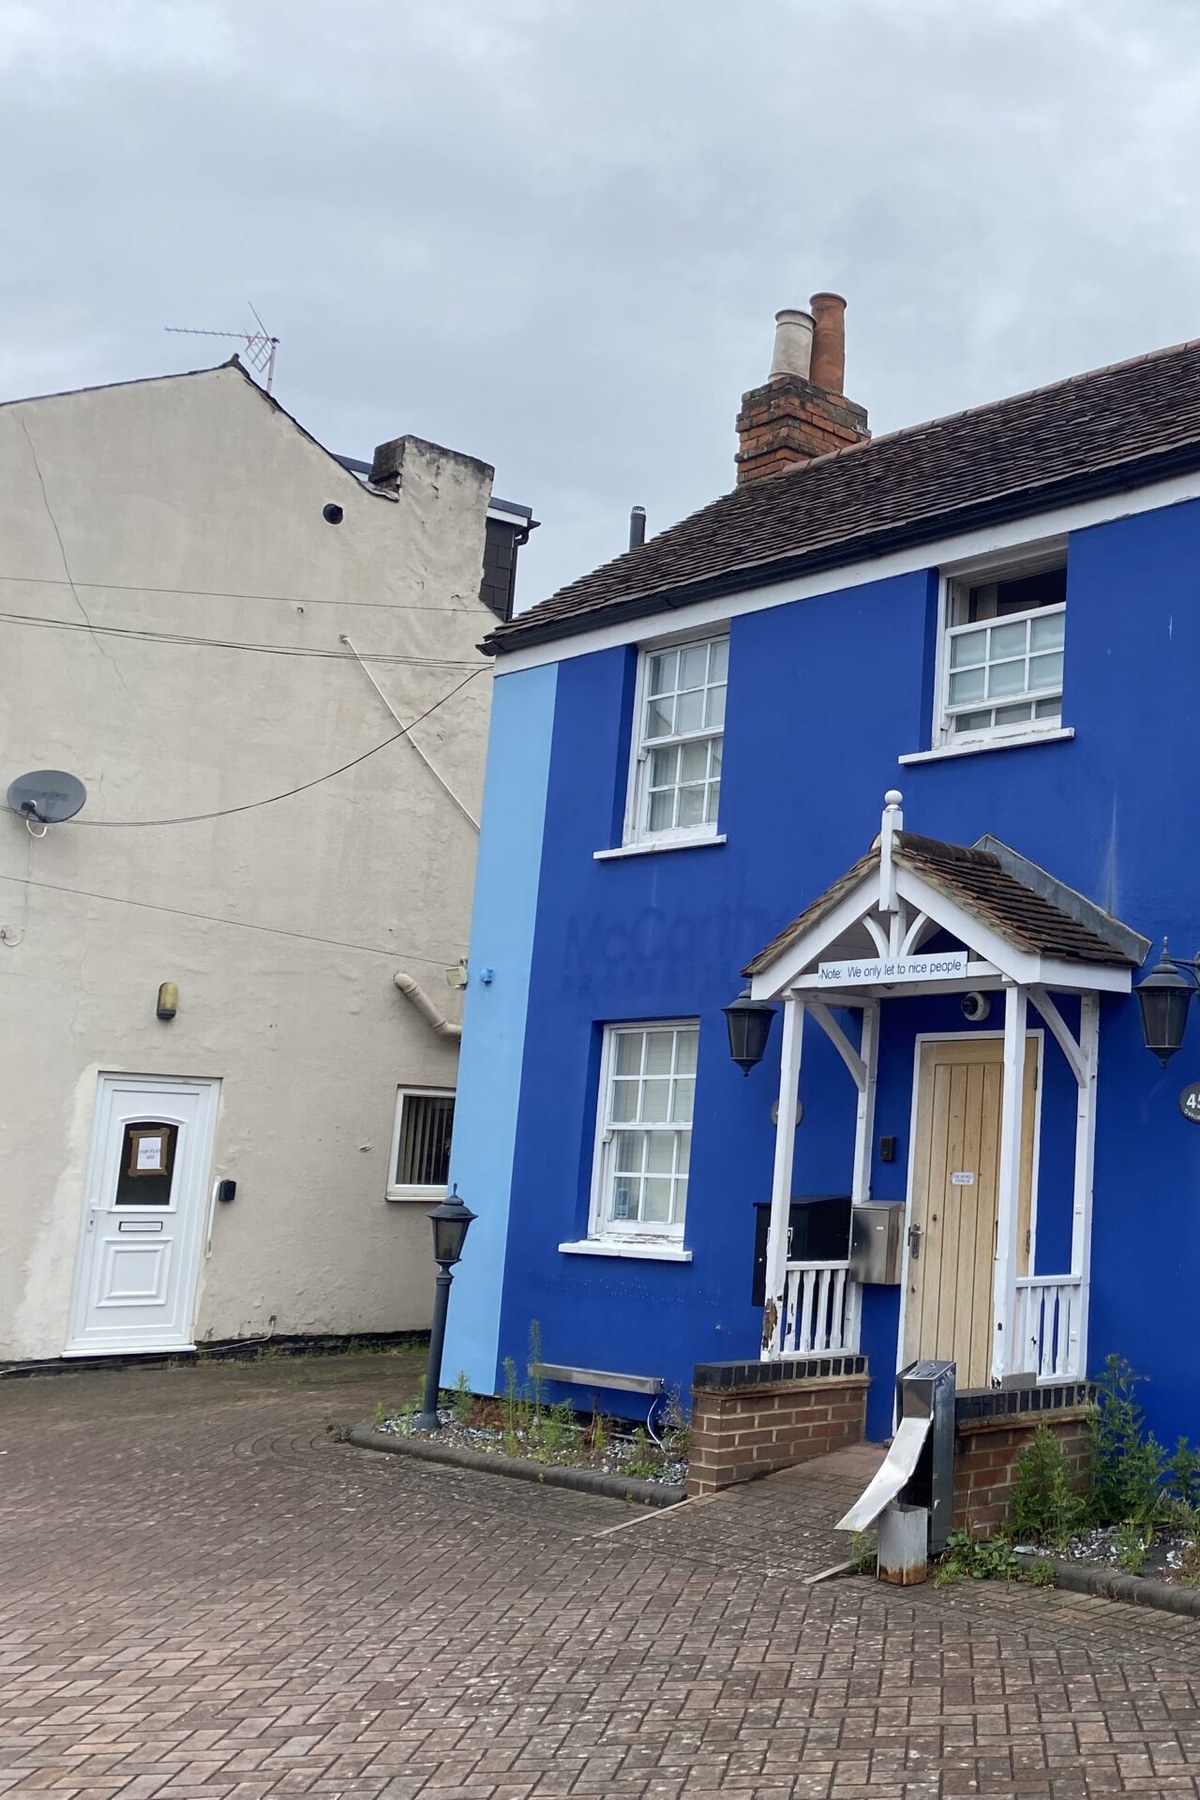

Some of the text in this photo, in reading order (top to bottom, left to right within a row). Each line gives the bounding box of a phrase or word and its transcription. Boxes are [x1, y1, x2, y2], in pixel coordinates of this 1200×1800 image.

[821, 959, 961, 980] Note: We only let to nice people
